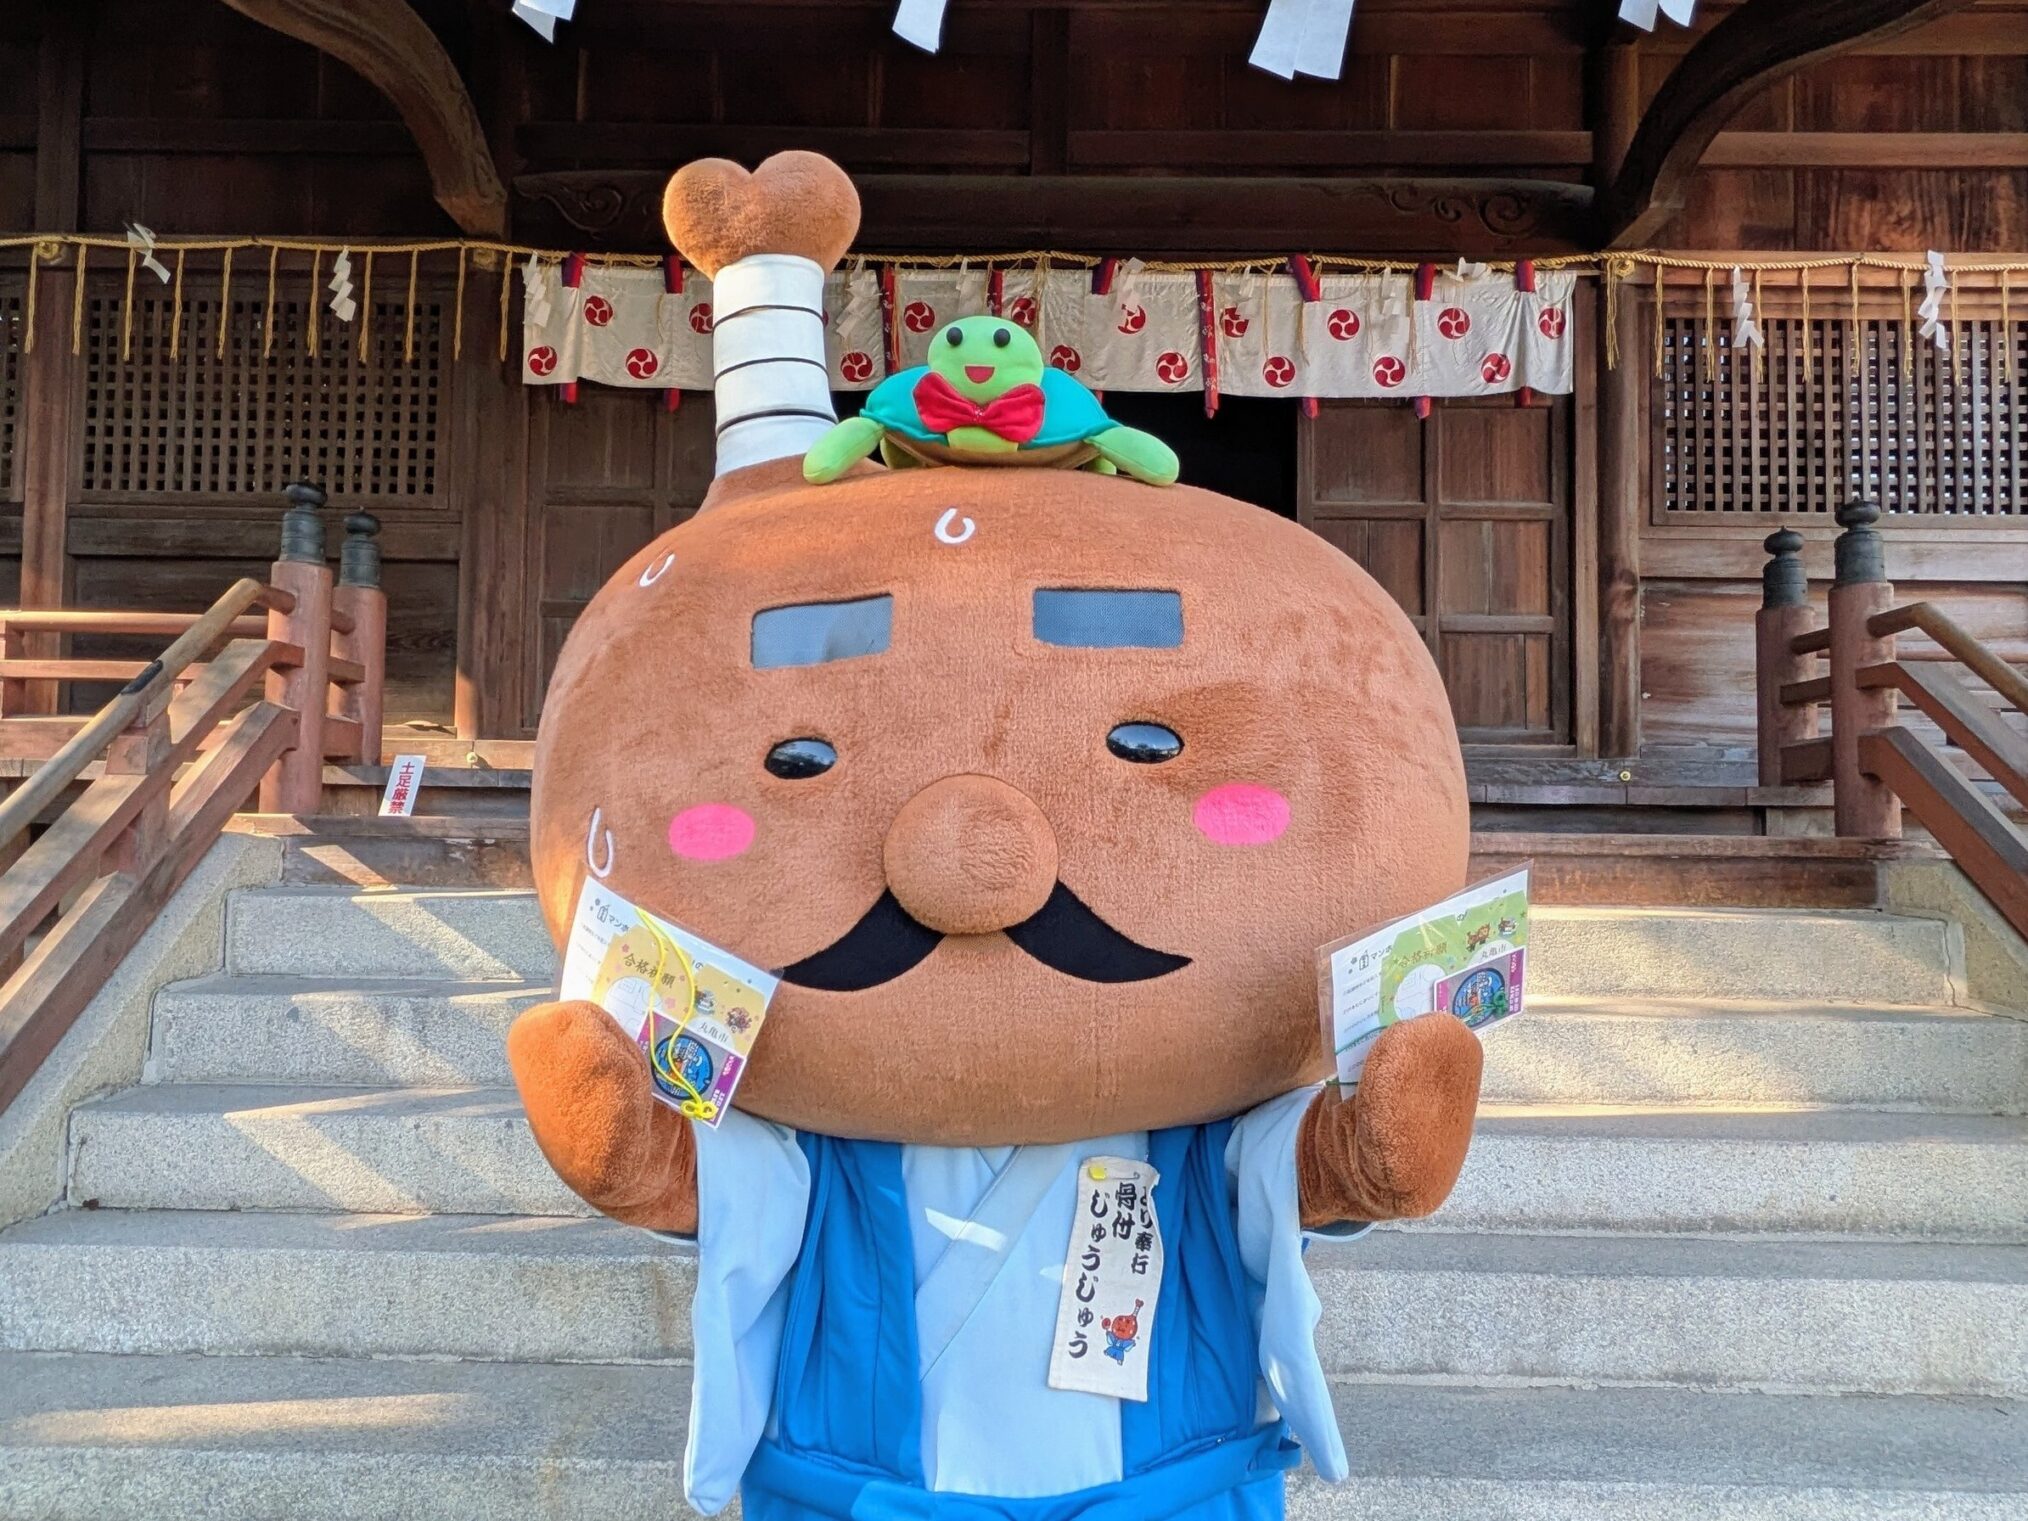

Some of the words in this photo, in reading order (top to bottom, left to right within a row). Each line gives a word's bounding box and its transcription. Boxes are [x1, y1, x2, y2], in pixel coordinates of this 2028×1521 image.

[388, 762, 415, 814] 土足厳禁
[1112, 1182, 1137, 1240] 骨付
[1068, 1189, 1110, 1359] じゅうじゅう
